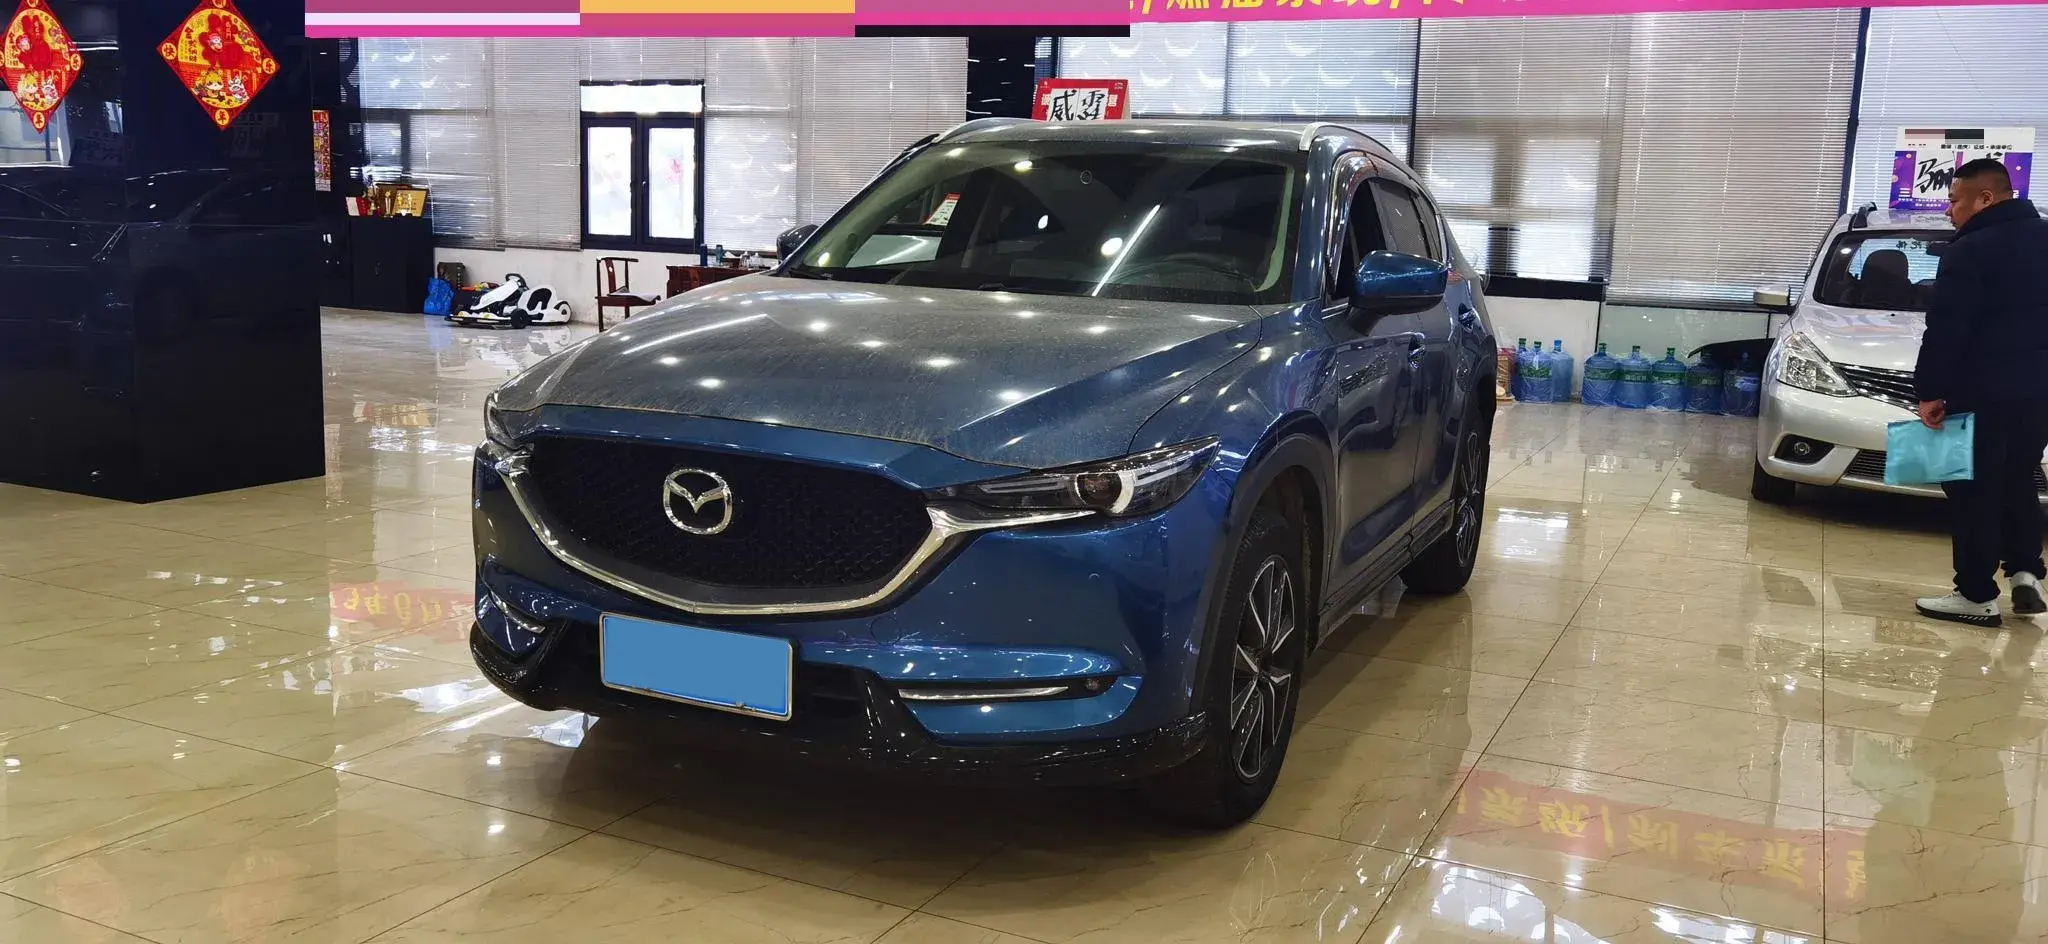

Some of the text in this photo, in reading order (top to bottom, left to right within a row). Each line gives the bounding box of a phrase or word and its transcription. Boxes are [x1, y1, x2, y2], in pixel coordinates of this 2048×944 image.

[163, 43, 176, 58] 快
[264, 59, 275, 73] 乐
[34, 113, 43, 129] 年
[217, 110, 229, 124] 年
